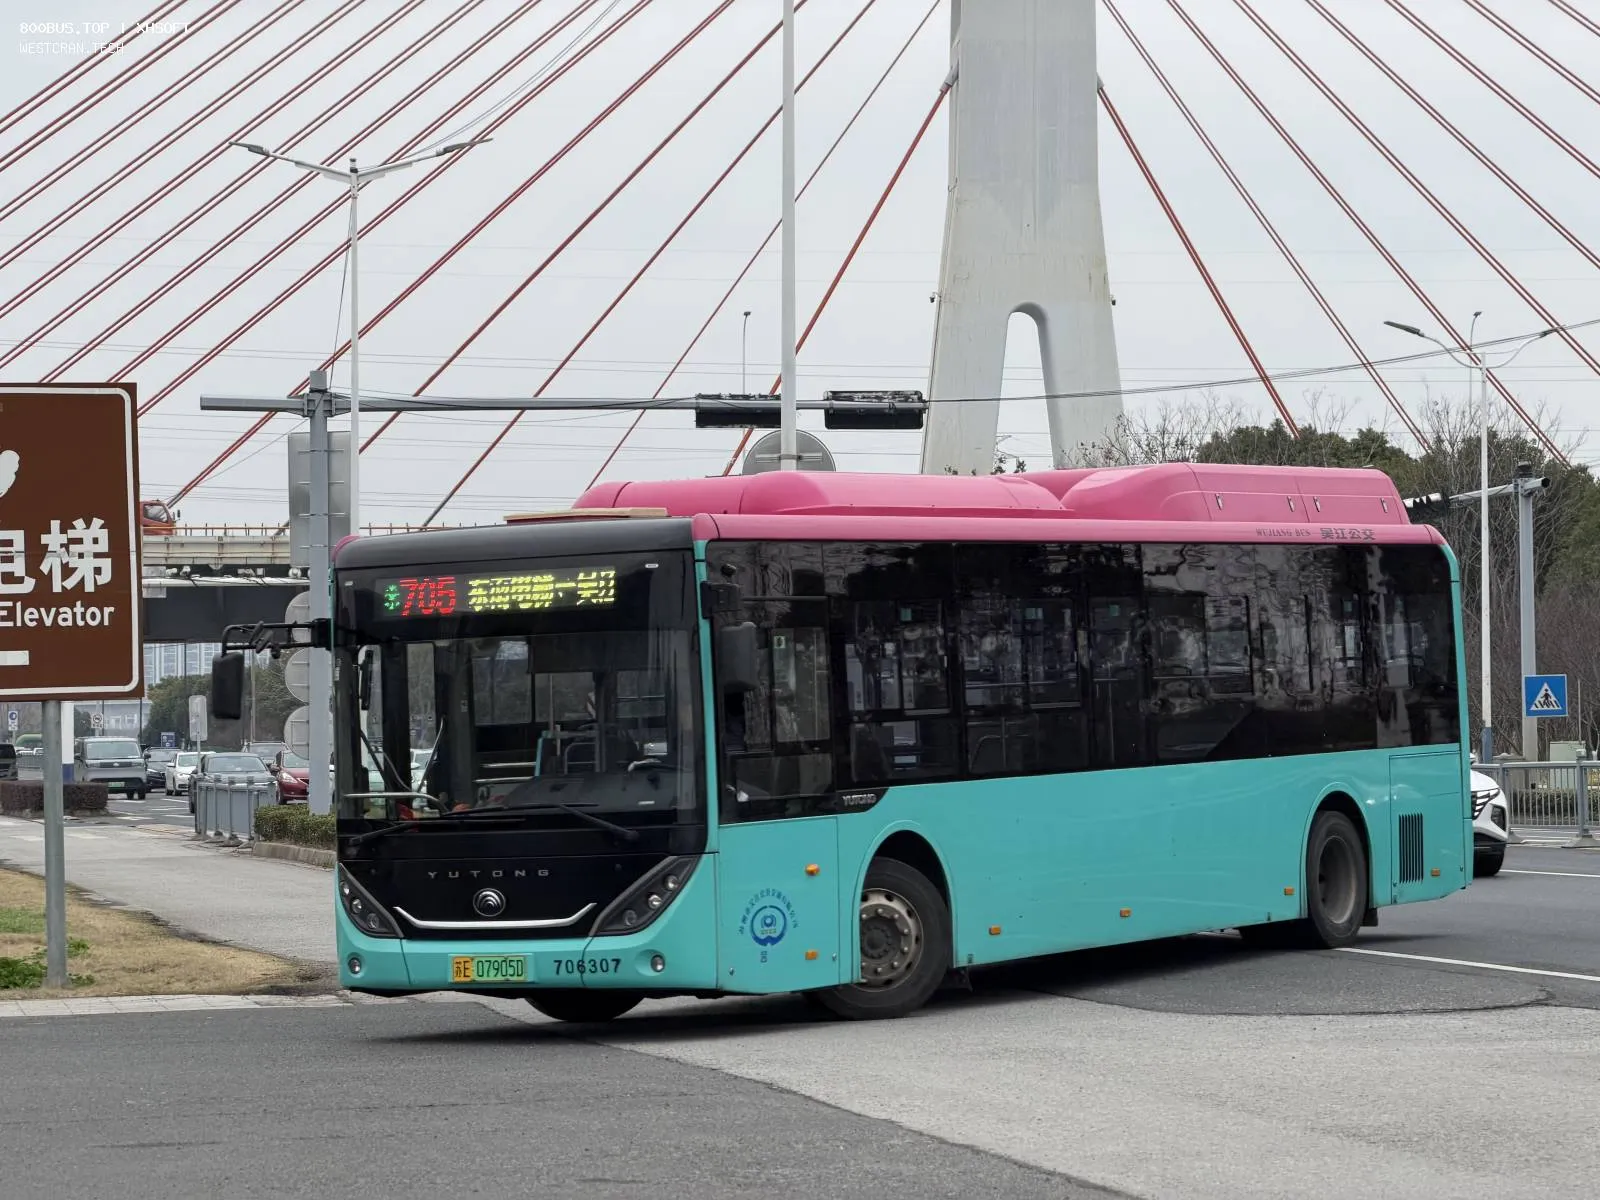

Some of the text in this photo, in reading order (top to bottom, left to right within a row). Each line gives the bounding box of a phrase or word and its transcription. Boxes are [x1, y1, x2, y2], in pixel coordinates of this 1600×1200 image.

[1320, 527, 1376, 540] 吴江公交
[400, 577, 456, 616] 705
[428, 869, 549, 879] YUTONG
[476, 959, 524, 977] 07905D
[553, 958, 621, 976] 706307
